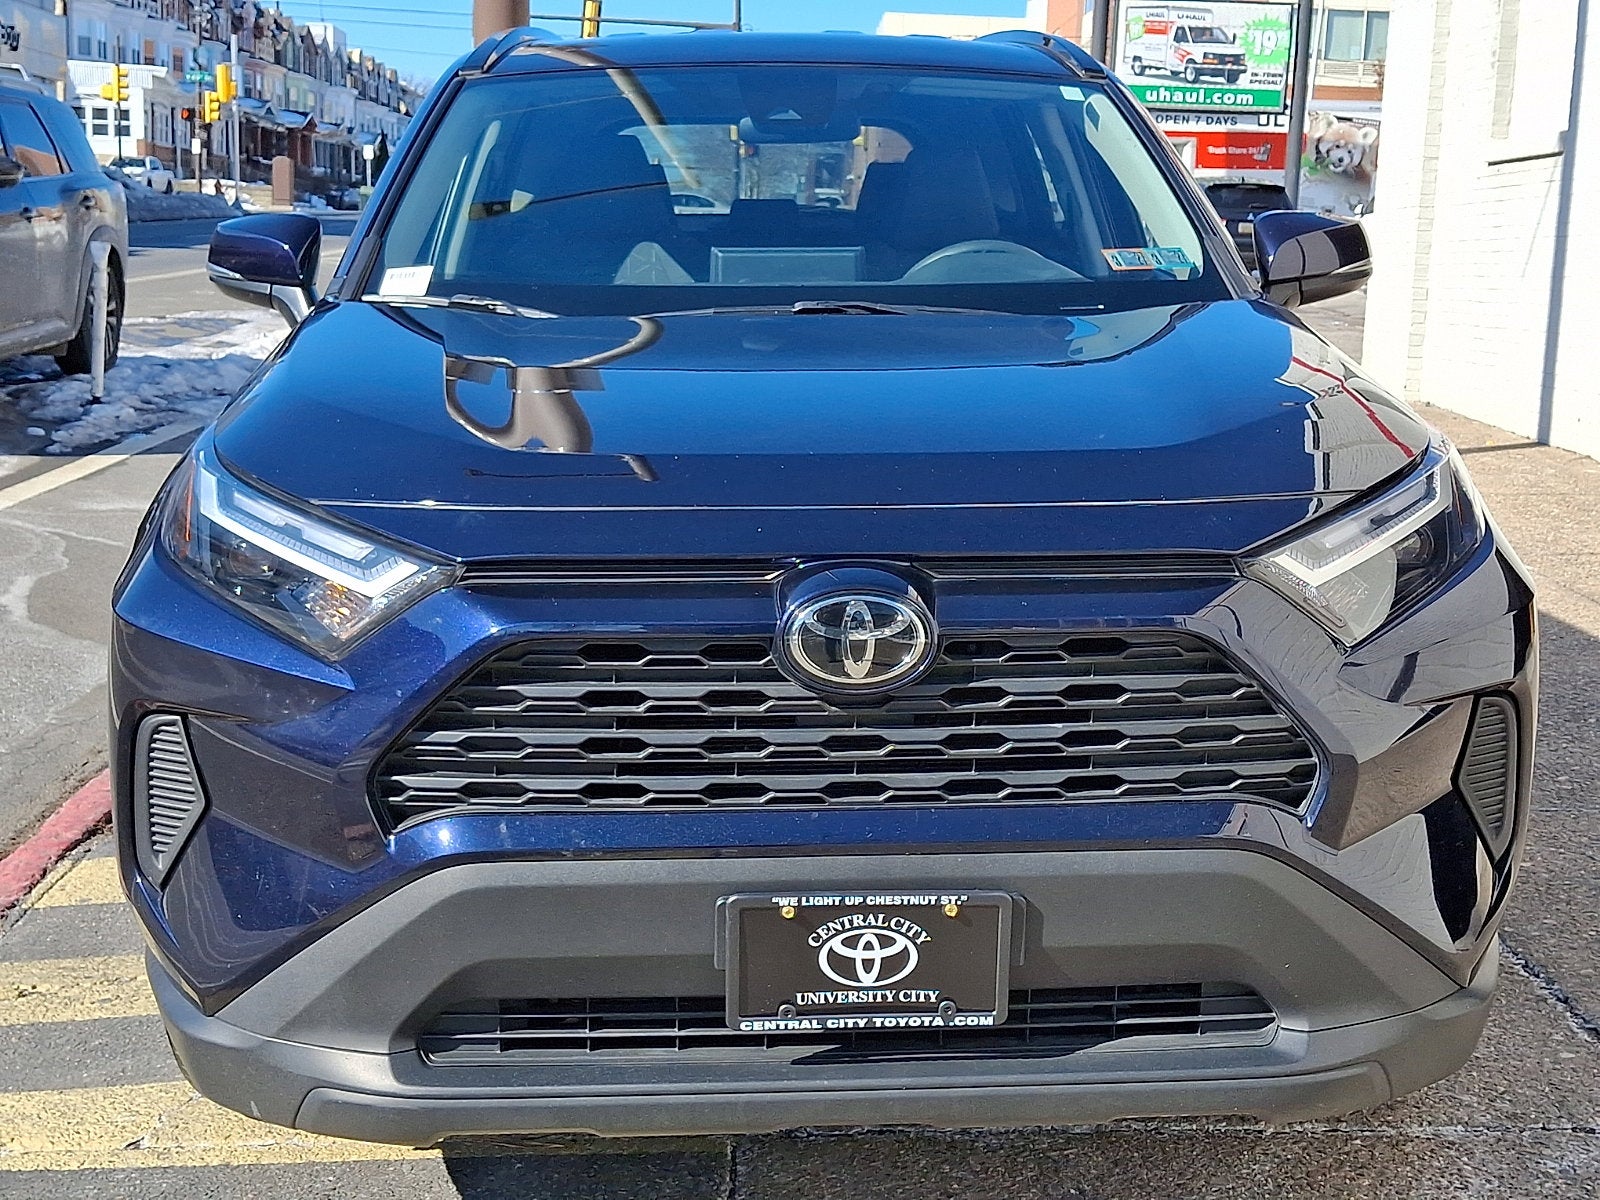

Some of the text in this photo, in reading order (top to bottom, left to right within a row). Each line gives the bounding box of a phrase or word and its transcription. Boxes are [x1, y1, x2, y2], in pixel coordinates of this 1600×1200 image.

[1145, 86, 1254, 105] uhaul.com
[1155, 114, 1238, 126] OPEN 7 DAYS
[801, 896, 842, 906] LIGHT
[844, 896, 863, 906] UP
[865, 895, 938, 906] CHESTNUT
[807, 913, 932, 947] CENTRAL CITY
[795, 989, 940, 1005] UNIVERSITY CITY
[740, 1015, 994, 1031] CENTRAL CITY TOYOTA .COM
